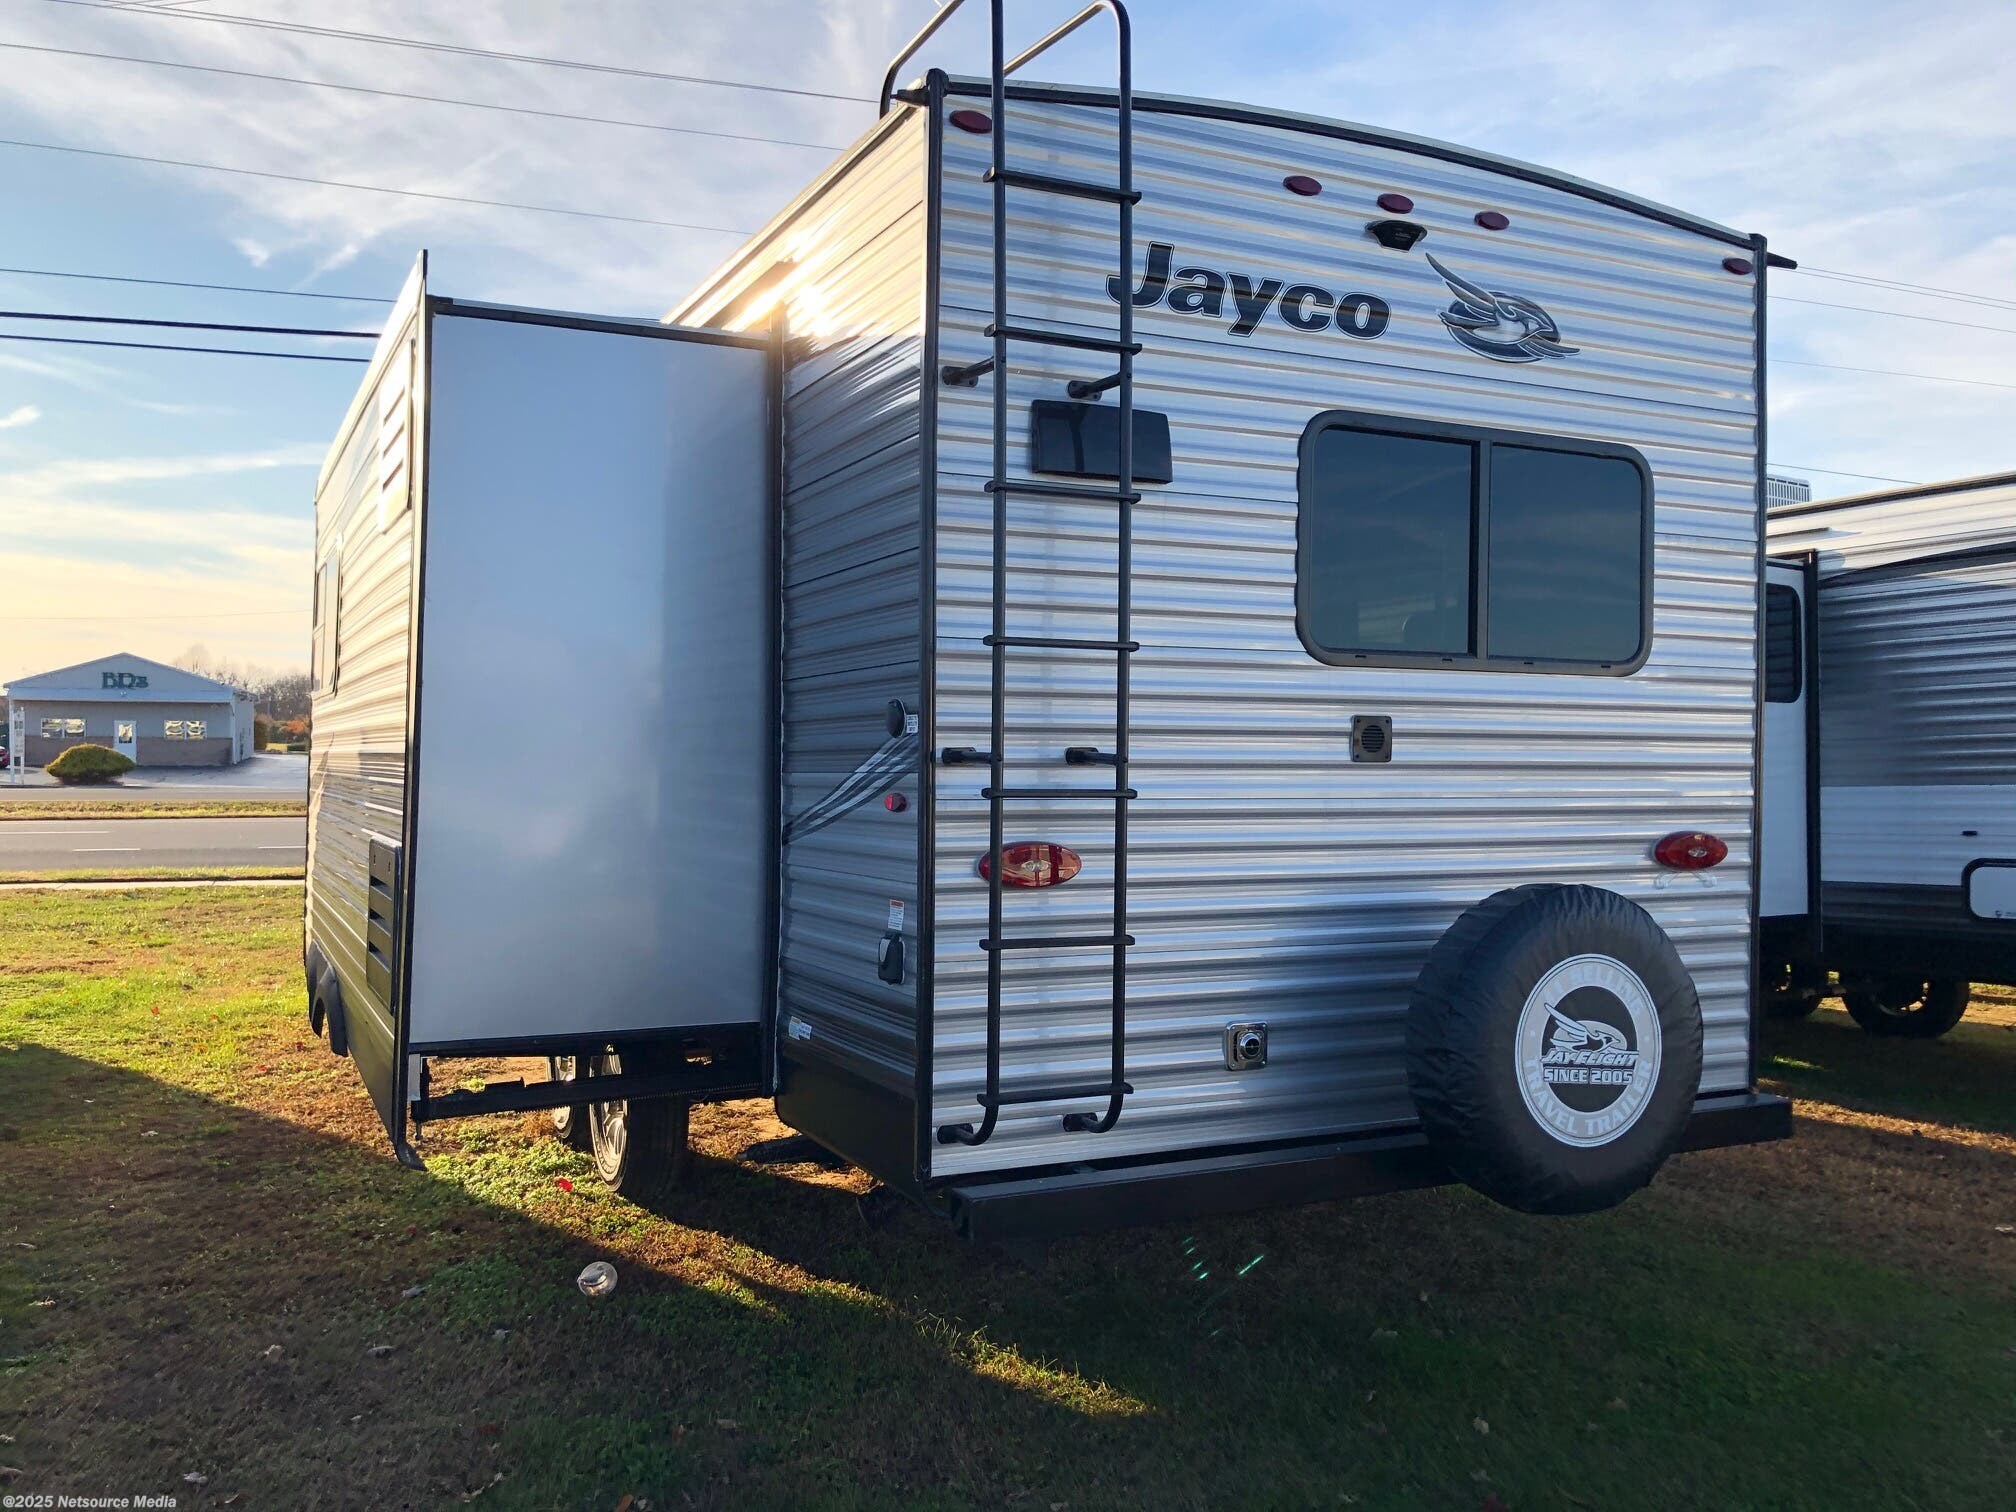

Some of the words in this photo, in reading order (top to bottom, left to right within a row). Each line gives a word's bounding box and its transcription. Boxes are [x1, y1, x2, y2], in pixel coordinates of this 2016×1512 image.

[1106, 241, 1392, 338] Jayco
[1524, 1059, 1578, 1135] TRAVEL
[1585, 1060, 1652, 1136] TRAILER
[1543, 1067, 1589, 1084] SINCE
[1589, 1068, 1634, 1085] 2005
